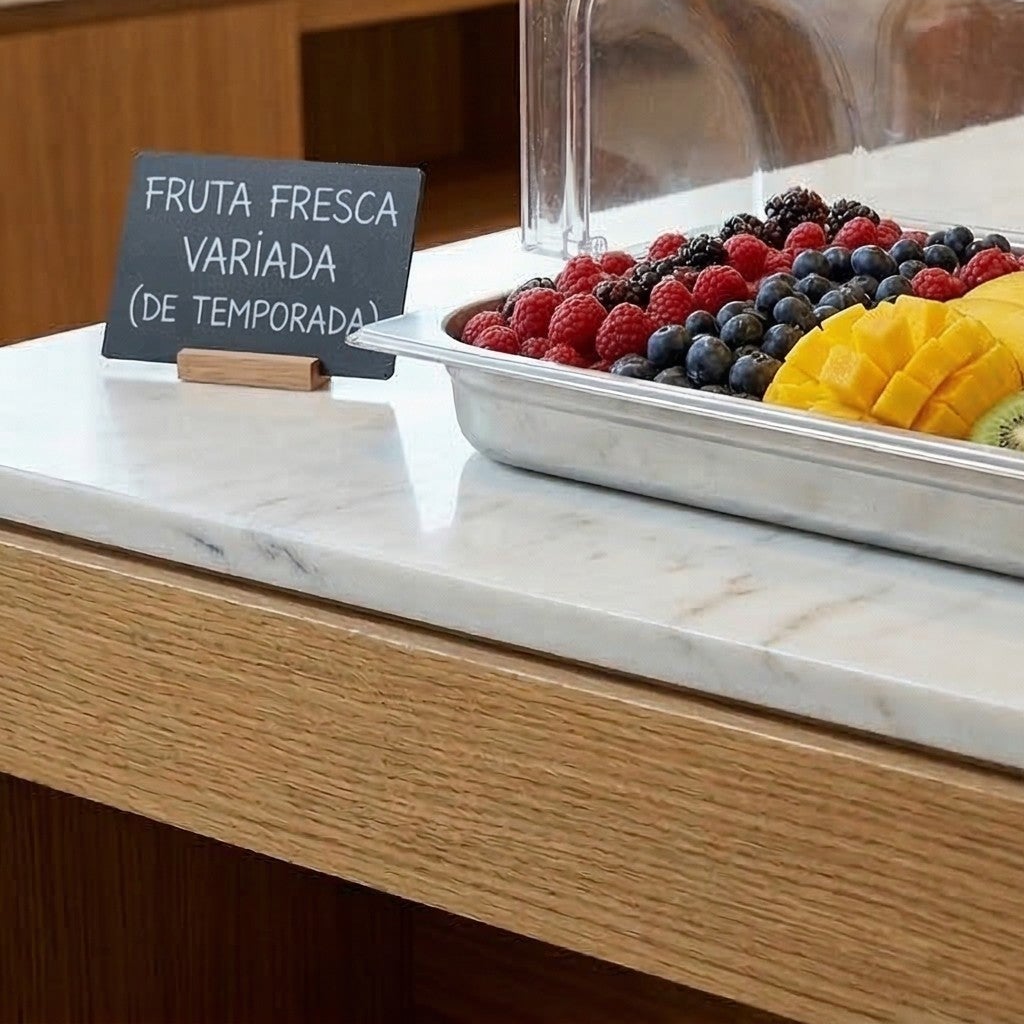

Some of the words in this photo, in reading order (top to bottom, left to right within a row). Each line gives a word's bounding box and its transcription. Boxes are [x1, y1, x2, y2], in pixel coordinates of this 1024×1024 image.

[145, 176, 252, 218] FRUTA
[270, 184, 399, 227] FRESCA
[129, 283, 178, 328] (DE
